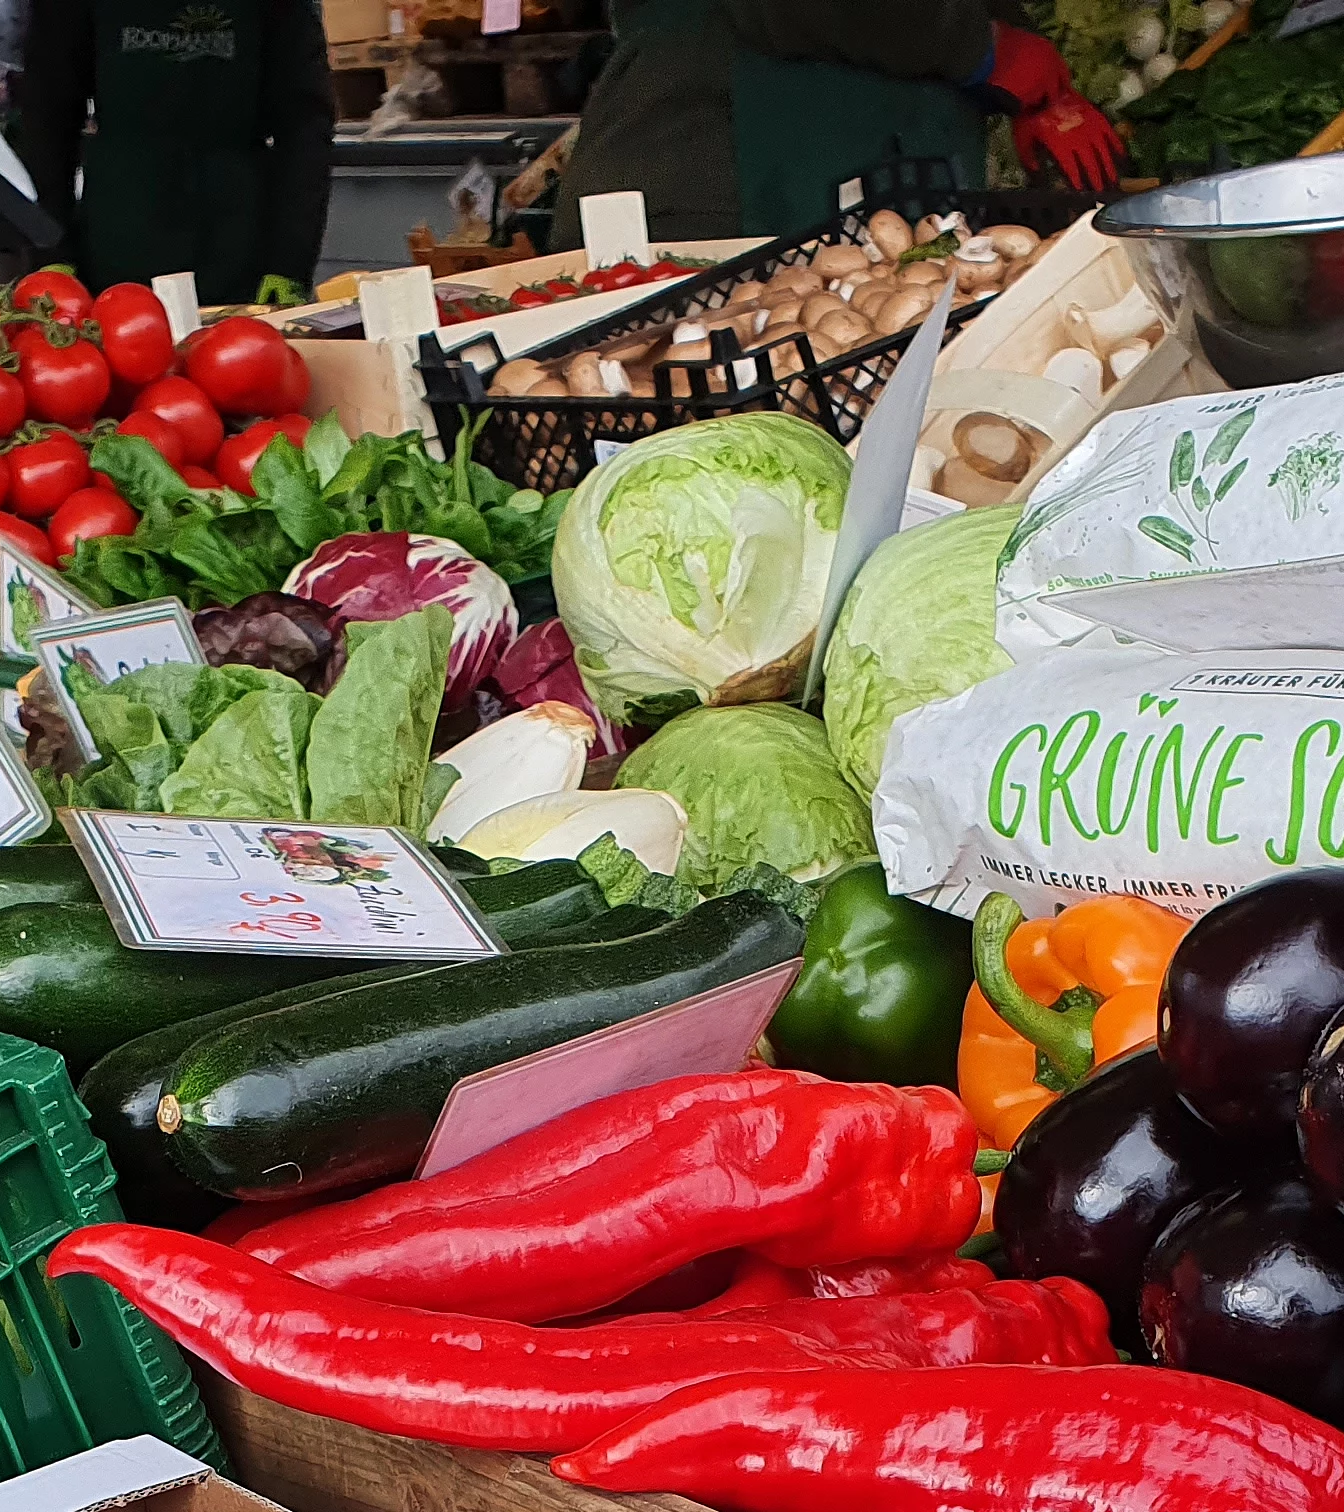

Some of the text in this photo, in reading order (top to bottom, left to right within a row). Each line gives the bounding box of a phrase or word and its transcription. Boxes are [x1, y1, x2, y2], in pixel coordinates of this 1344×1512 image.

[1205, 669, 1301, 689] KRÄUTER
[987, 692, 1264, 854] GRÜNE
[981, 854, 1034, 884] IMMER
[1123, 879, 1197, 898] IMMER
